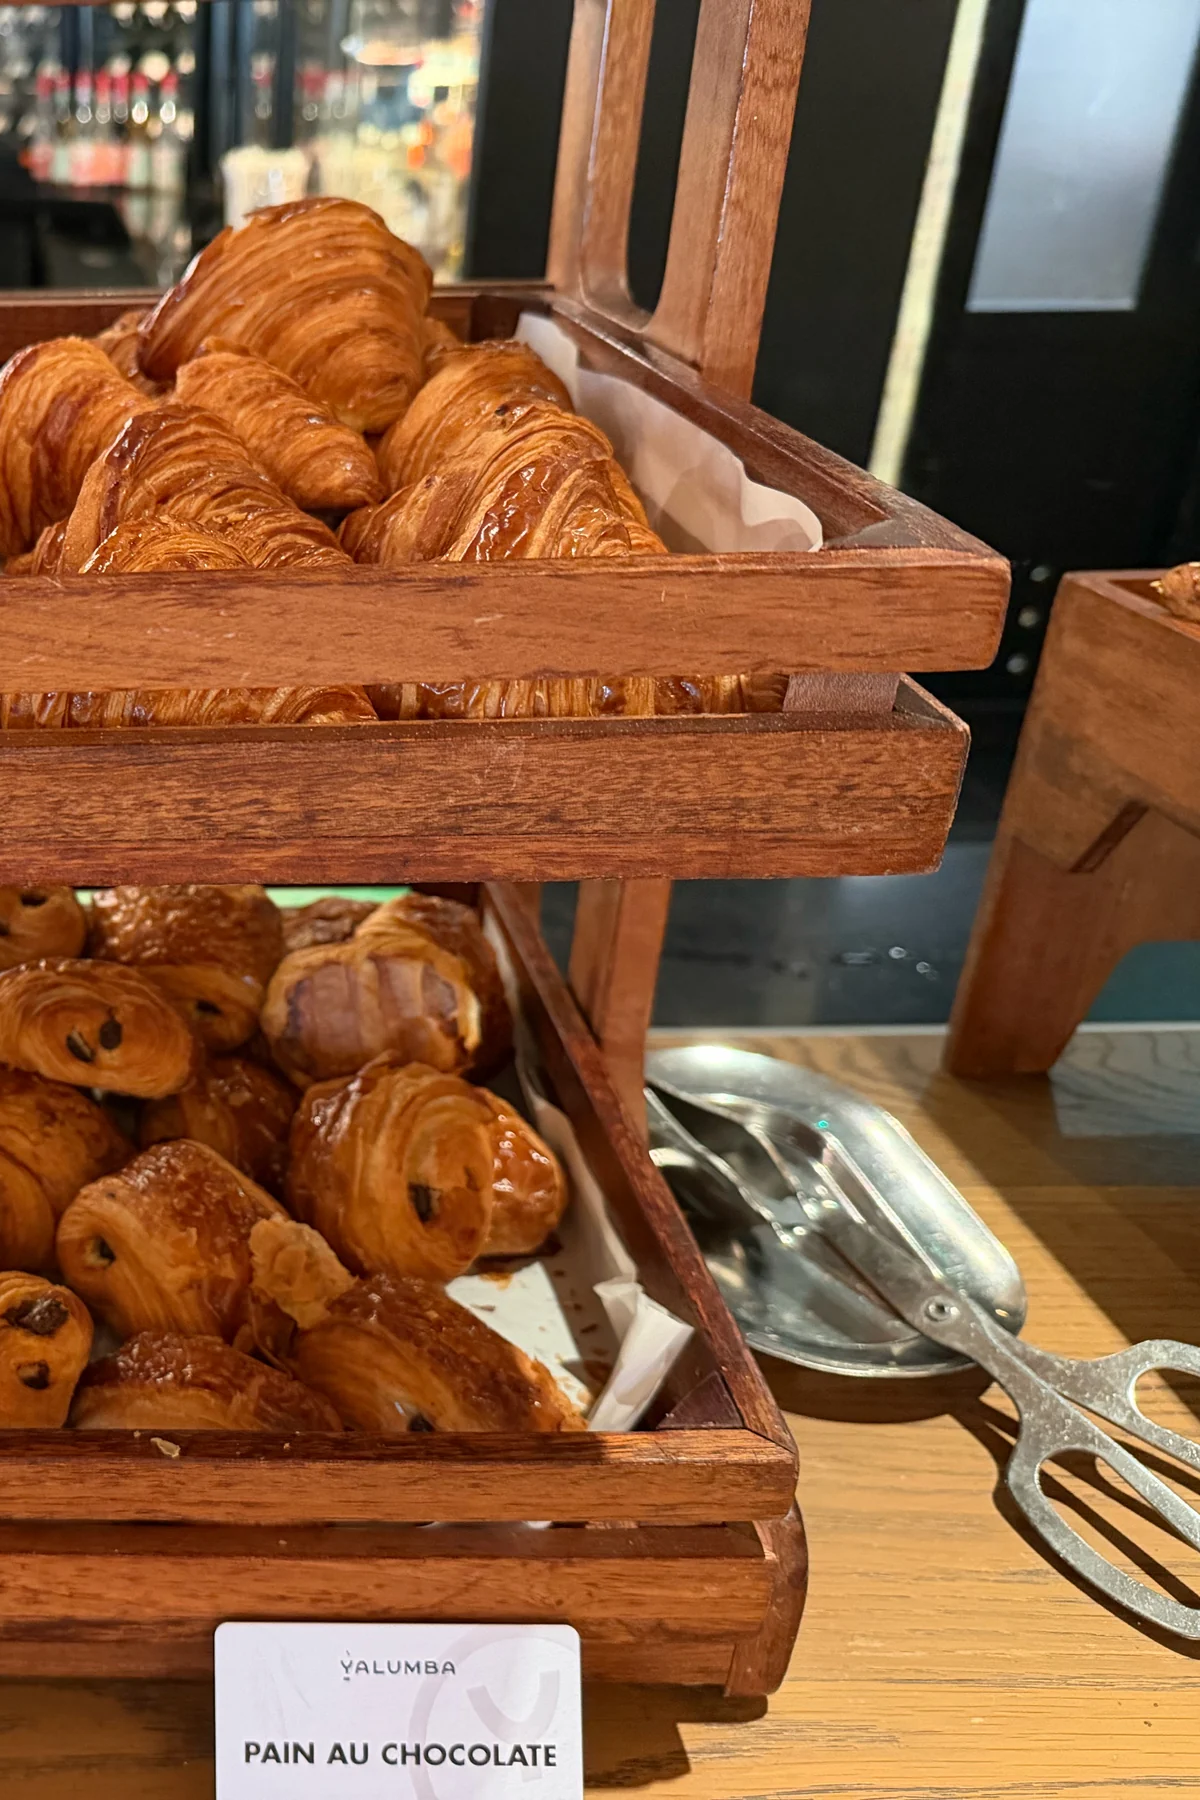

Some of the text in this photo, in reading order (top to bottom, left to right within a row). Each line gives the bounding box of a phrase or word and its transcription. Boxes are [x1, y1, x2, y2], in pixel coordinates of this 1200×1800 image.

[340, 1659, 456, 1681] YALUMBA
[244, 1741, 557, 1767] PAIN AU CHOCOLATE
